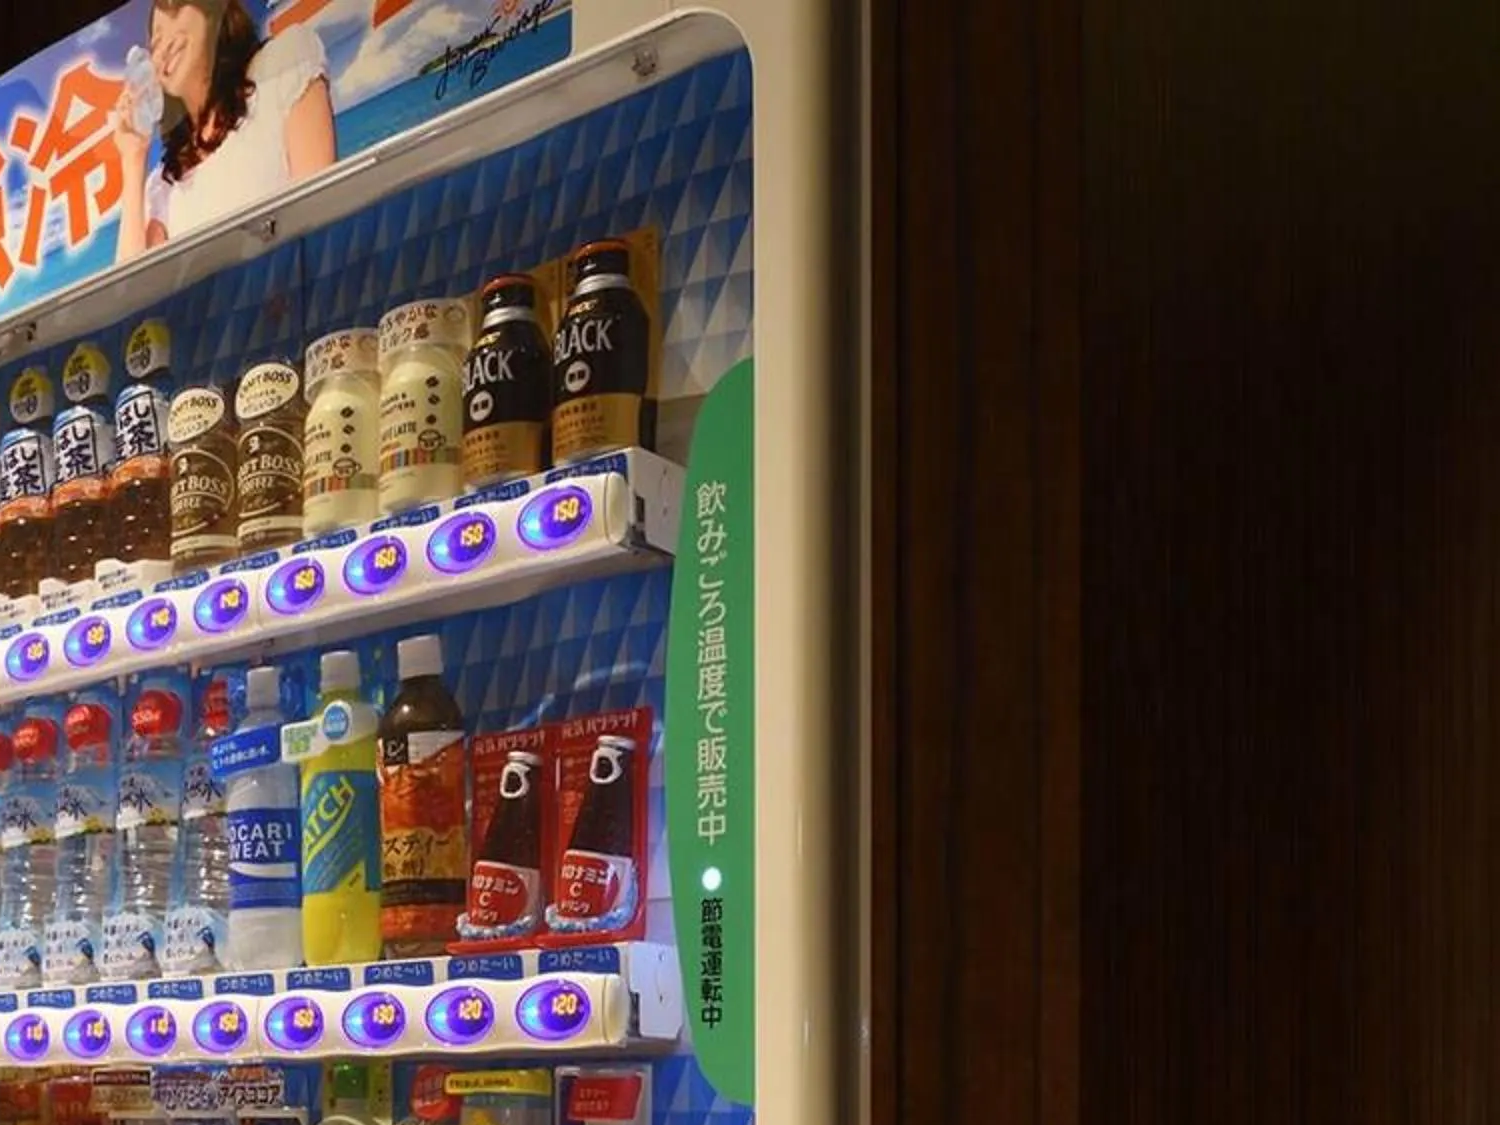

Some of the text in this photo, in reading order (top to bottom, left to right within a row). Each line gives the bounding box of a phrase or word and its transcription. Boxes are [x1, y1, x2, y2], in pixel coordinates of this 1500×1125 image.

[553, 496, 580, 522] 150
[461, 520, 485, 546] 150
[696, 480, 728, 846] 飲みごろ温度で販売中
[303, 775, 356, 847] ATCH
[228, 822, 293, 842] OCARI
[228, 839, 286, 860] WEAT
[479, 891, 492, 907] C
[570, 882, 582, 898] C
[701, 898, 723, 1029] 節電運転中
[458, 998, 484, 1021] 120
[552, 993, 579, 1016] 120
